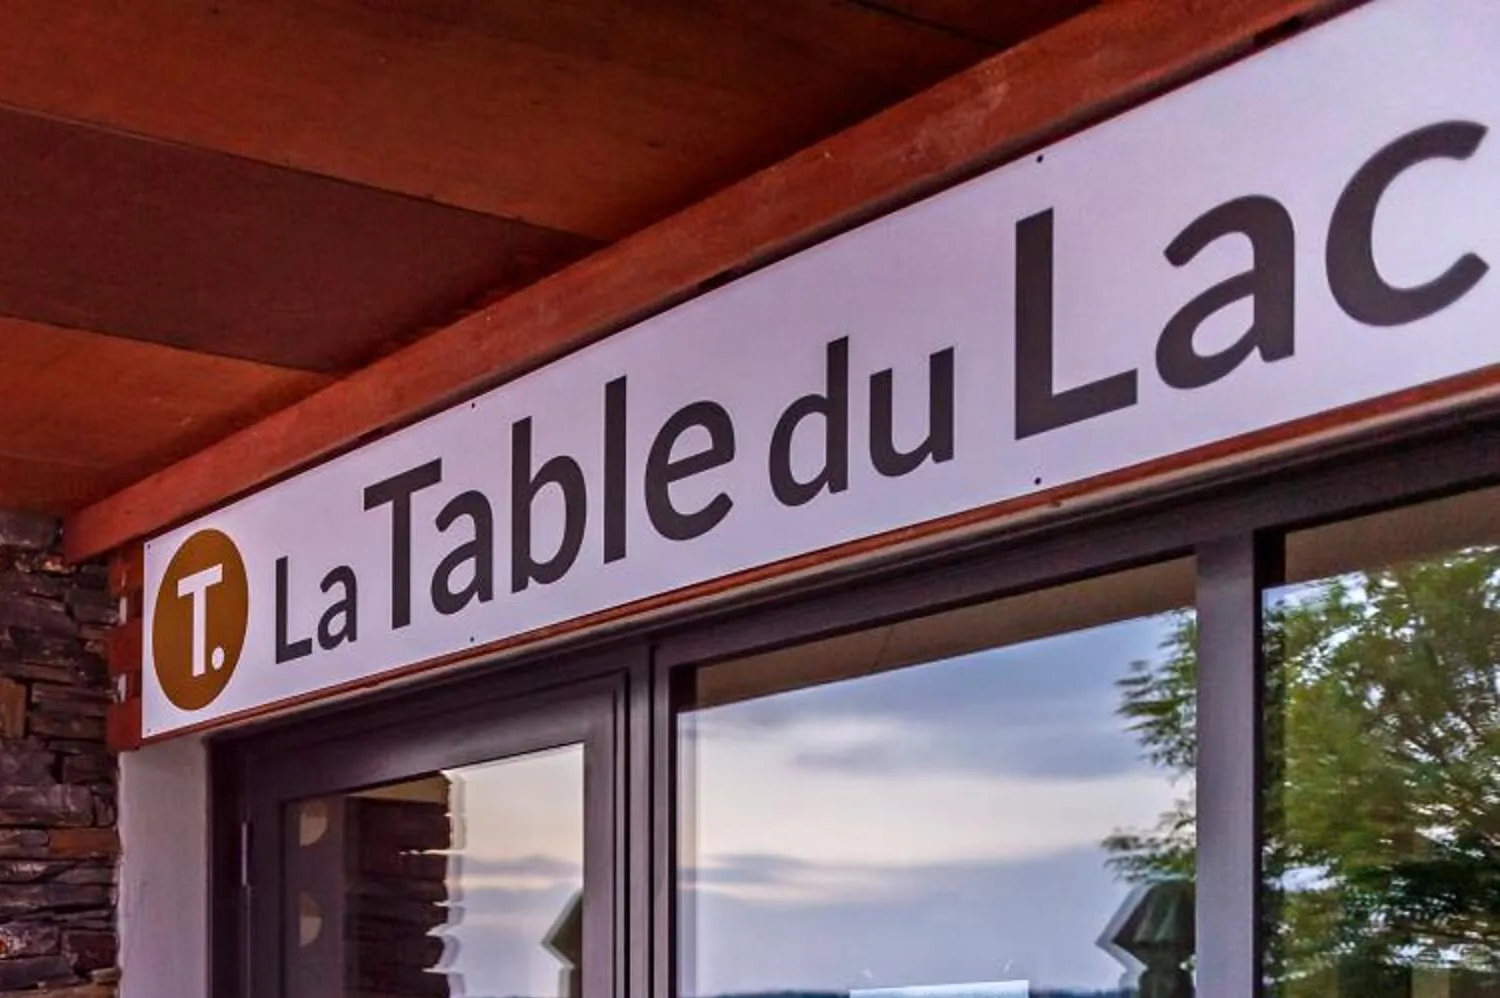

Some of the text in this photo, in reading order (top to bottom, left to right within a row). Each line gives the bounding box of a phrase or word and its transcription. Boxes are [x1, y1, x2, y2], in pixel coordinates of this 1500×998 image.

[275, 555, 358, 665] La
[363, 374, 736, 631] Table
[768, 335, 955, 507] du
[1014, 119, 1490, 440] Lac
